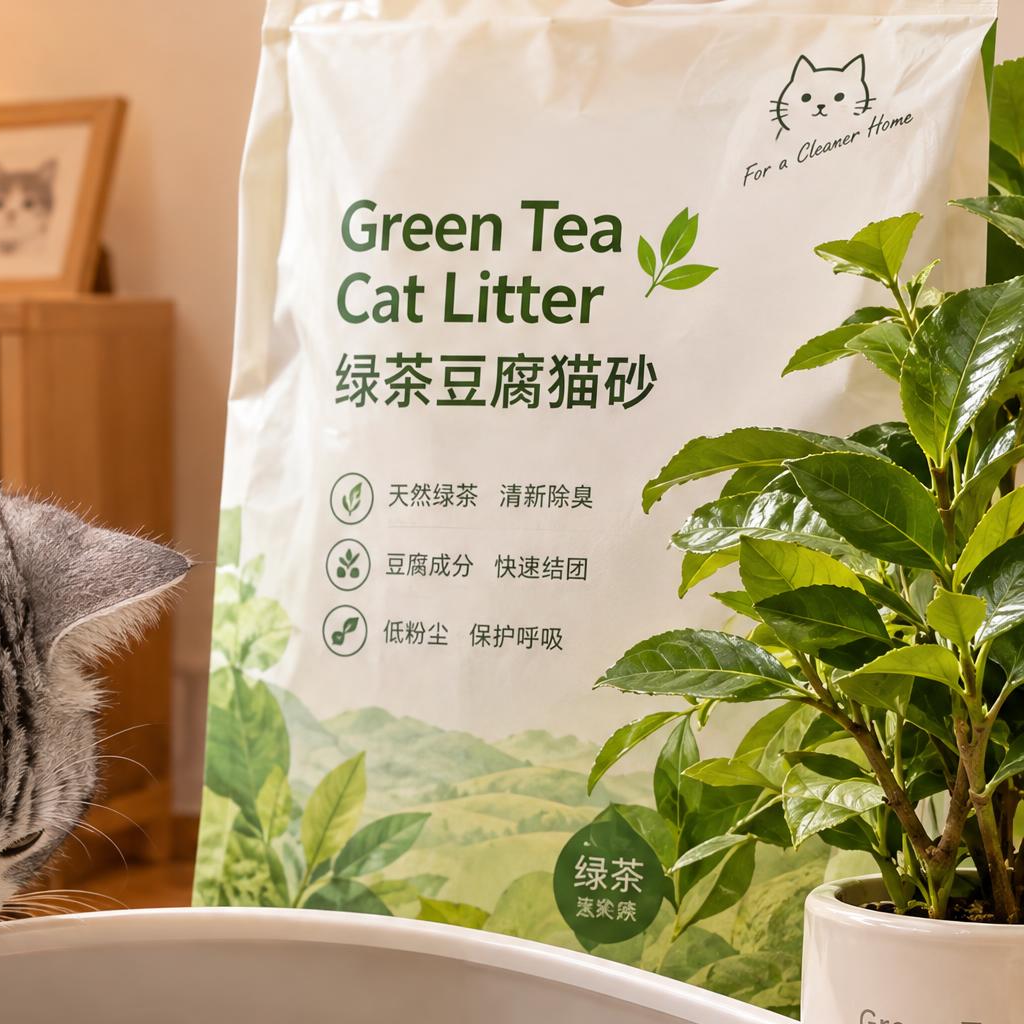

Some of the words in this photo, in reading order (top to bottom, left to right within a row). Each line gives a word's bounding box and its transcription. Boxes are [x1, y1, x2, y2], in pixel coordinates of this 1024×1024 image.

[743, 162, 772, 187] For
[778, 159, 788, 170] a
[797, 131, 861, 163] Cleaner
[867, 113, 914, 138] Home
[341, 199, 503, 252] Green
[521, 200, 622, 253] Tea
[337, 272, 425, 324] Cat
[444, 270, 605, 324] Litter
[335, 352, 658, 410] 绿茶豆腐猫砂
[388, 483, 478, 508] 天然绿茶
[499, 483, 593, 509] 清新除臭
[385, 552, 474, 578] 豆腐成分
[494, 554, 588, 581] 快速结团
[383, 619, 449, 646] 低粉尘
[469, 623, 563, 651] 保护呼吸
[574, 855, 644, 893] 绿茶
